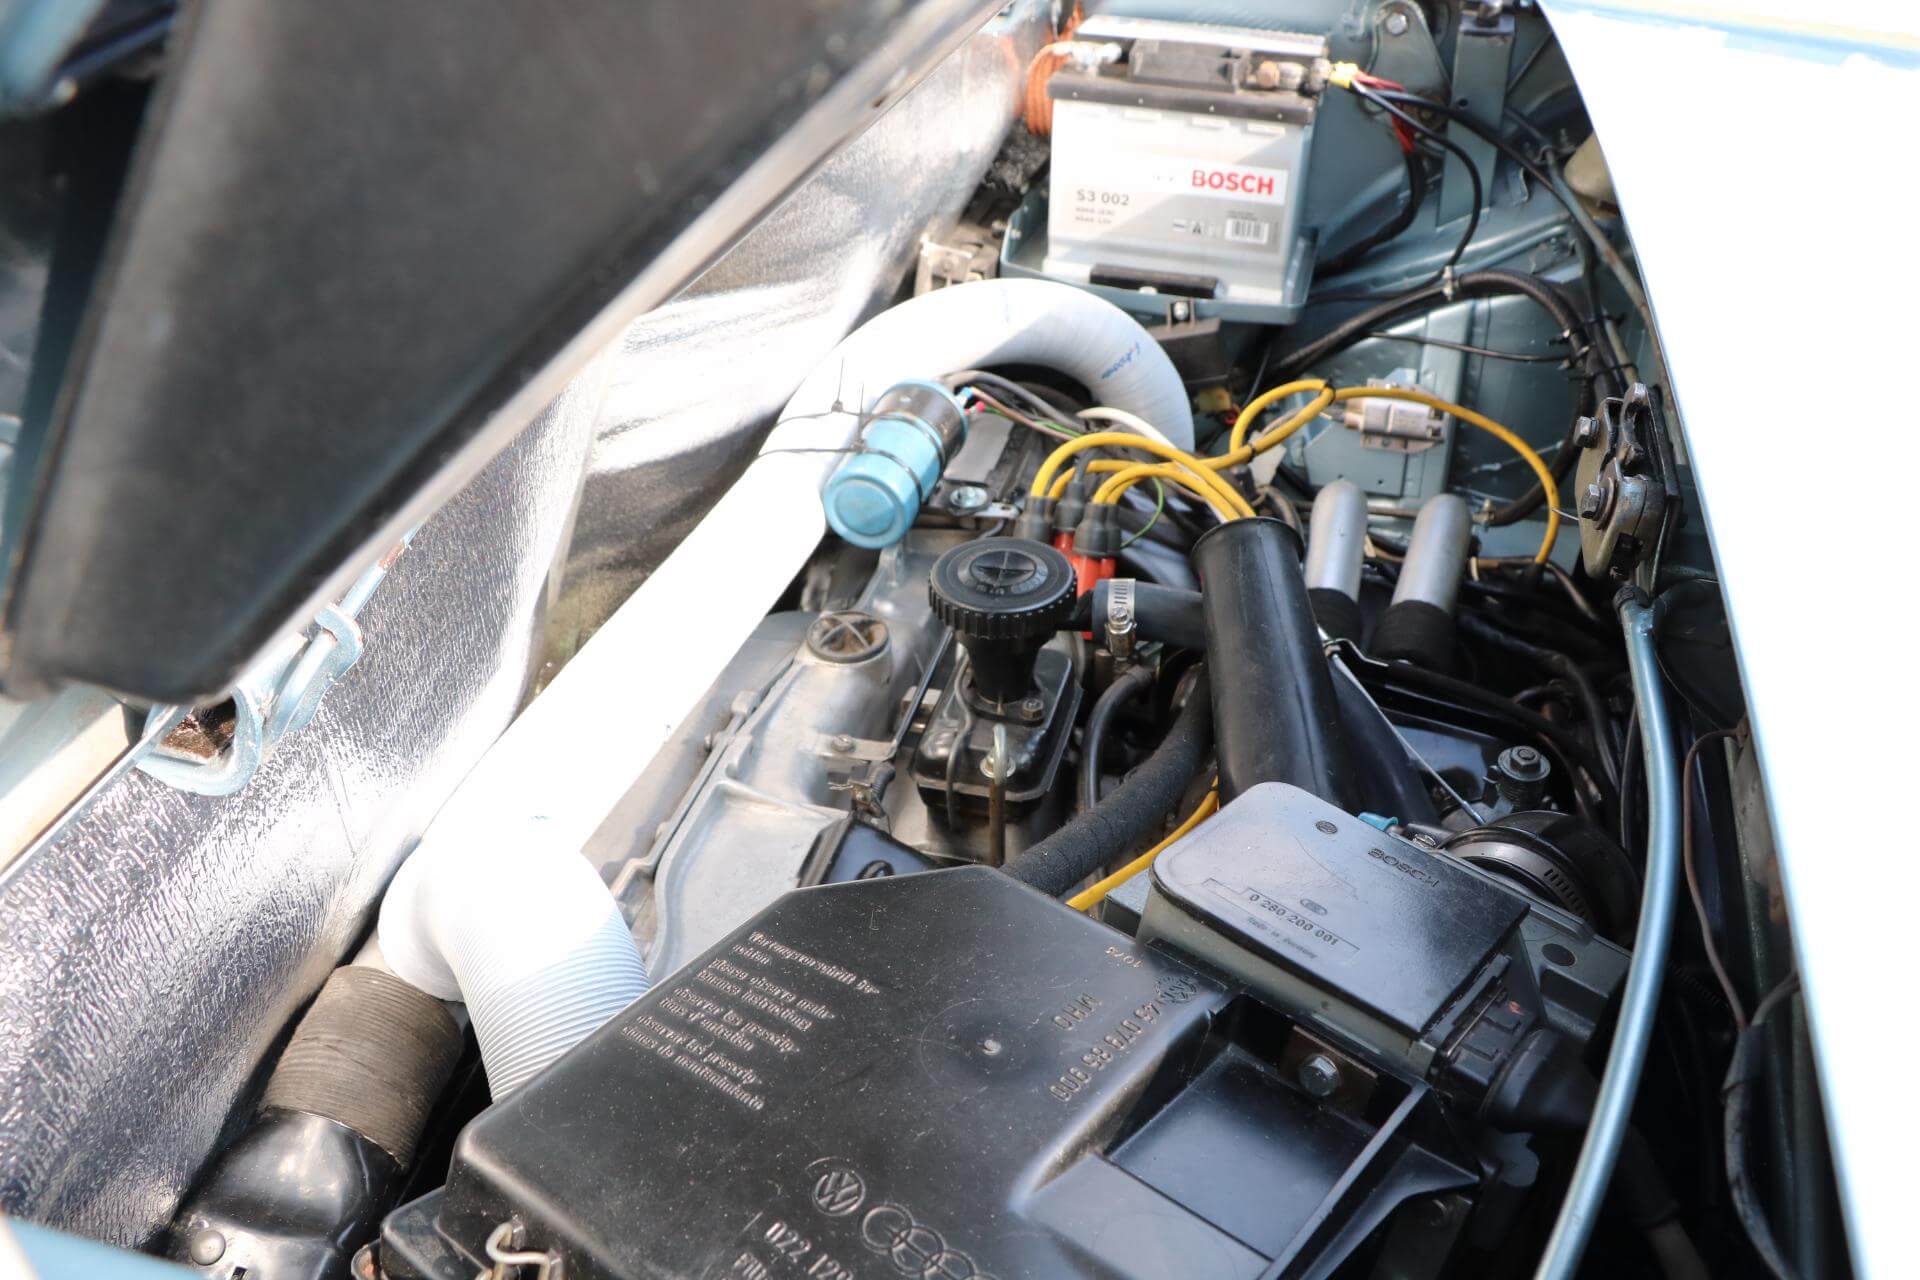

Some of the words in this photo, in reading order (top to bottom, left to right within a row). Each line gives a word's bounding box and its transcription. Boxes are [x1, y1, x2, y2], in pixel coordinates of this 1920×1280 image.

[1076, 189, 1096, 203] S3
[1100, 191, 1130, 207] 002
[1192, 170, 1275, 196] BOSCH
[1367, 847, 1441, 888] BOSCH
[1260, 899, 1287, 918] 280
[1288, 914, 1314, 933] 200
[1314, 928, 1340, 947] 001
[764, 1221, 812, 1264] 022
